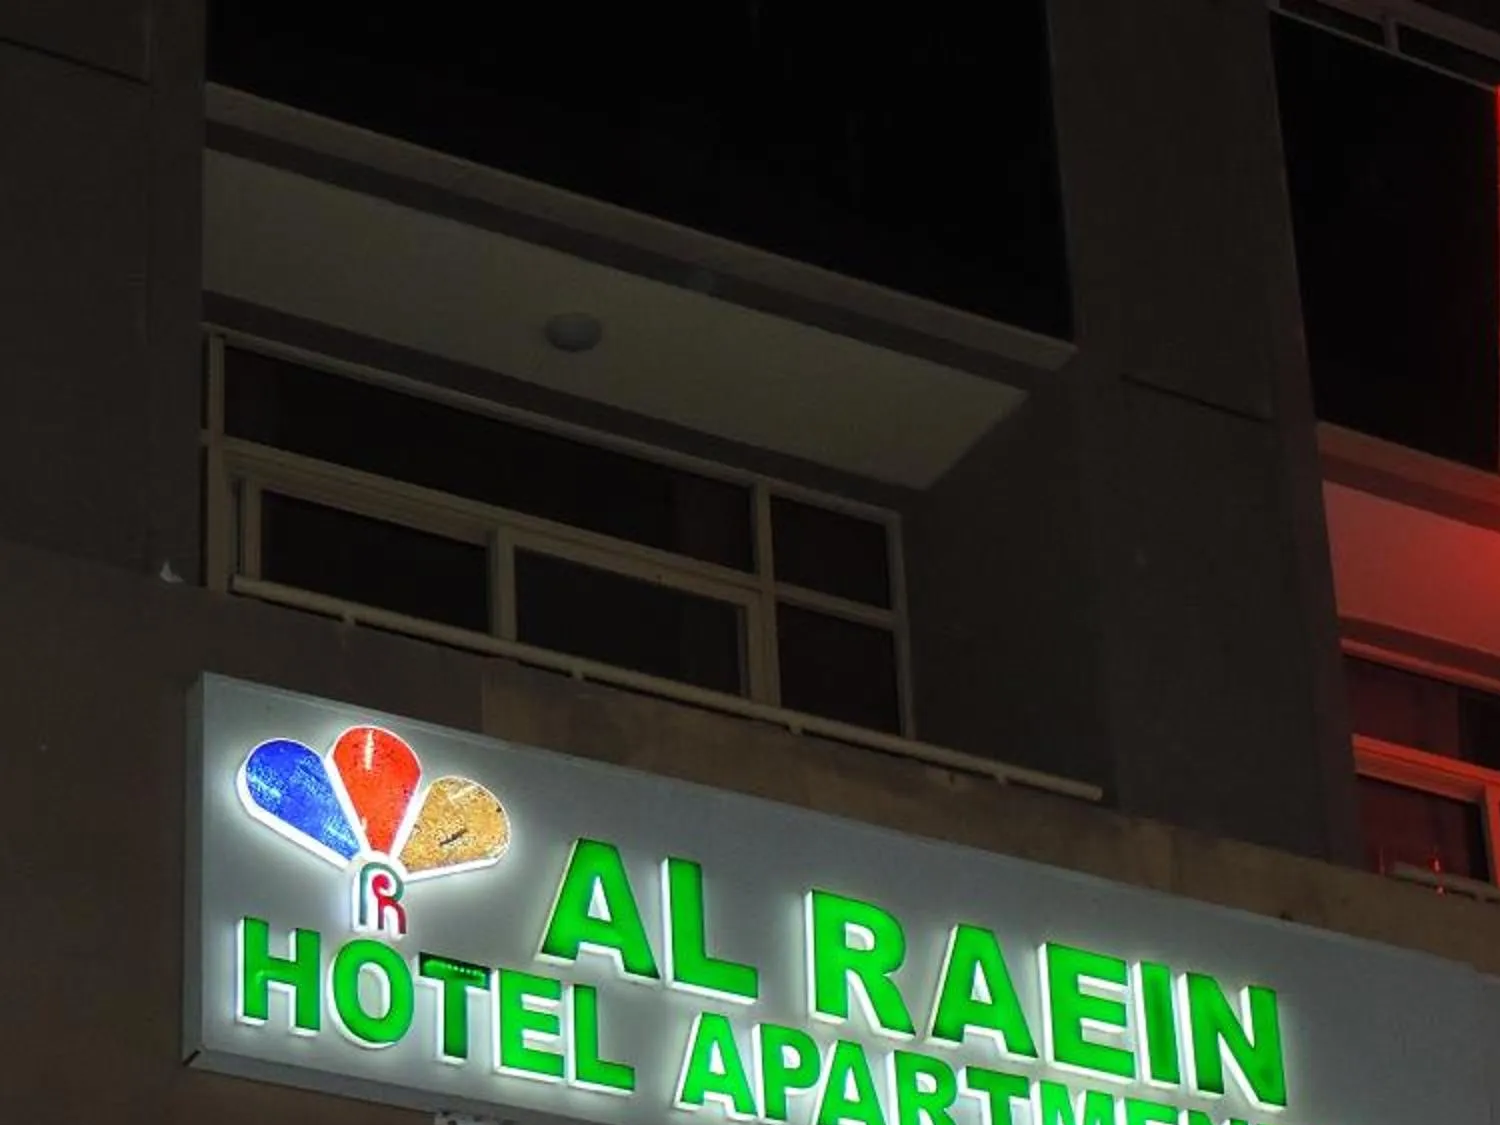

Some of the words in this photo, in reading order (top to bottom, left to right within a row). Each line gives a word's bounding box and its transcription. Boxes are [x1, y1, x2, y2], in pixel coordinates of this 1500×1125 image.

[235, 914, 637, 1095] HOTEL
[536, 836, 760, 1004] AL
[804, 887, 1288, 1109] RAEIN
